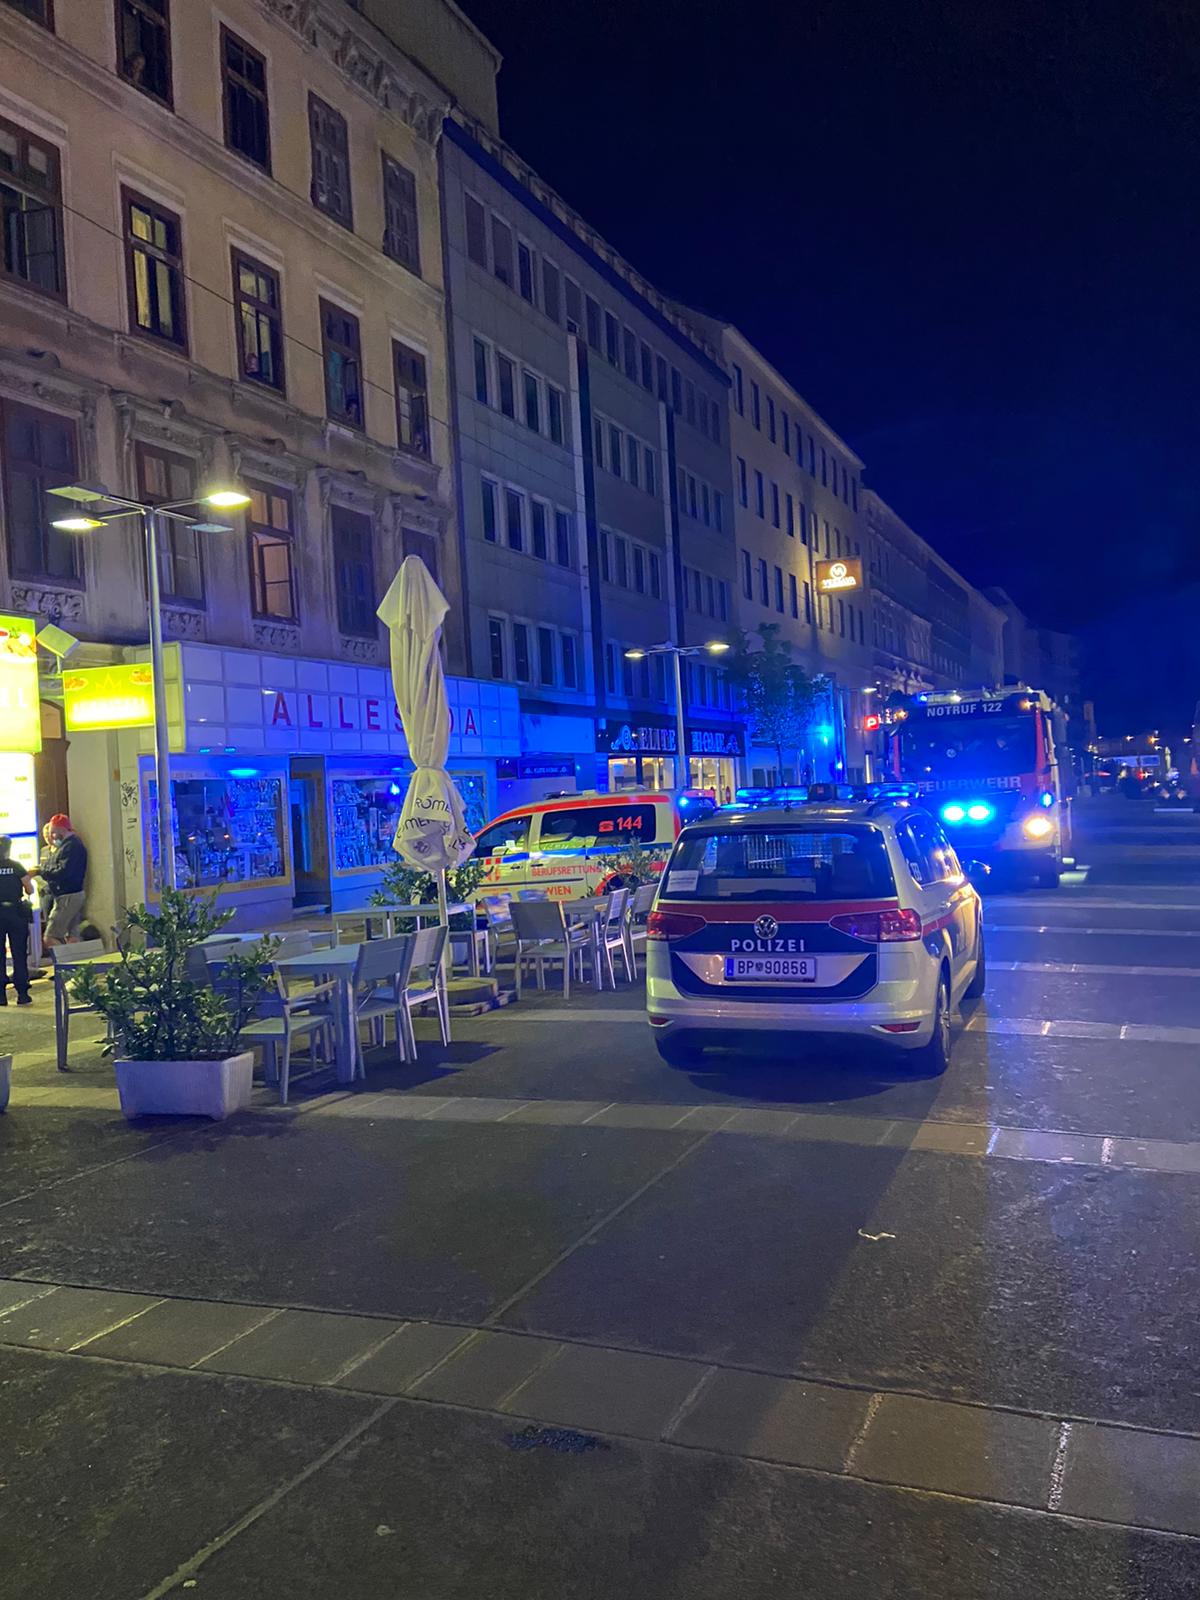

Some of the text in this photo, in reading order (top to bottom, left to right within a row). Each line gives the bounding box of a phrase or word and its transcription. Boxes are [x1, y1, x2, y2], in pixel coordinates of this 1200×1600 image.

[926, 702, 1003, 717] NOTRUF 122
[639, 727, 727, 753] ELITE HOME
[918, 776, 1022, 792] FEUERWEHR
[616, 815, 643, 831] 144
[731, 939, 806, 952] POLIZEI
[738, 960, 754, 974] BP
[764, 960, 808, 975] 90858
